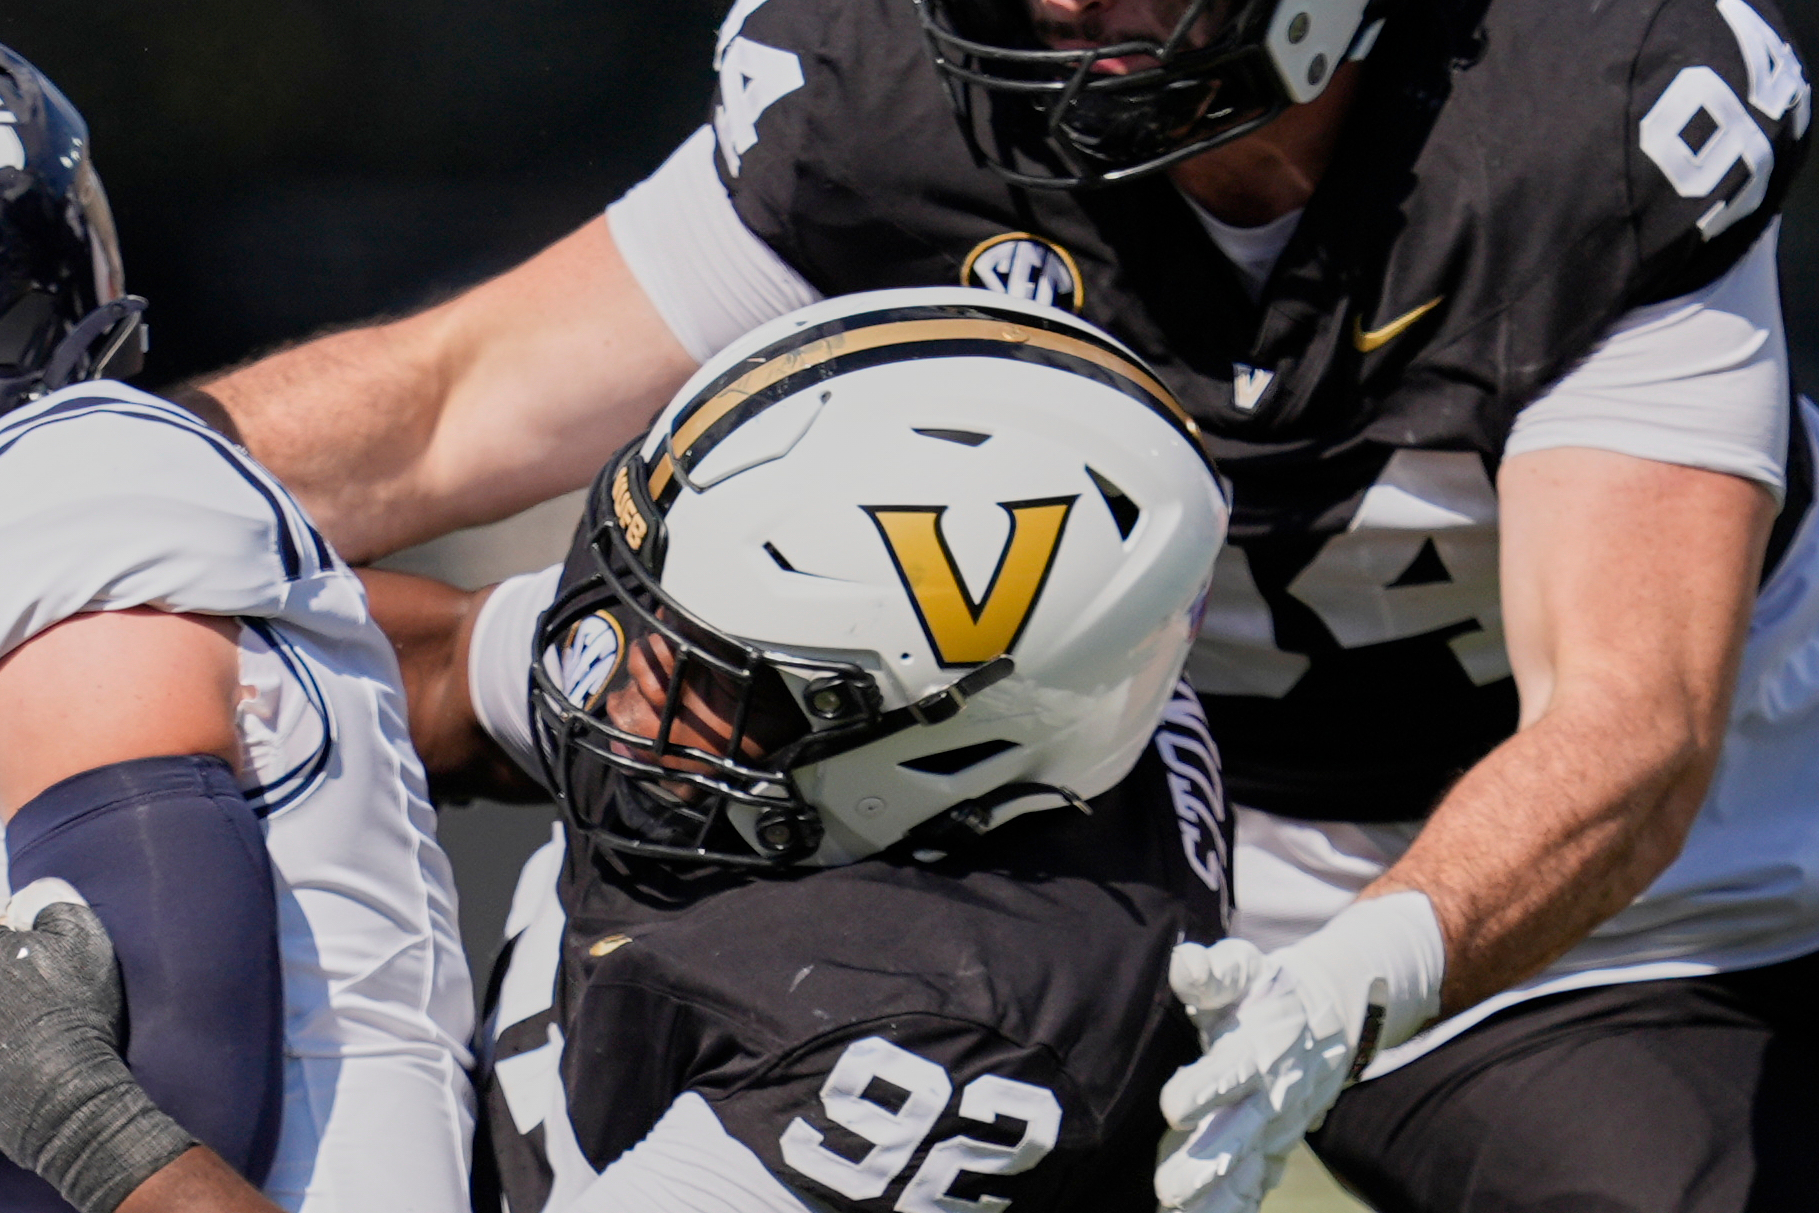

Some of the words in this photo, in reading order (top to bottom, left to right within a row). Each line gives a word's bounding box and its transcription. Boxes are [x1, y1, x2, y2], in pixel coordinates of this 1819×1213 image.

[713, 0, 805, 178] 4
[1639, 0, 1812, 242] 94
[857, 493, 1083, 669] V
